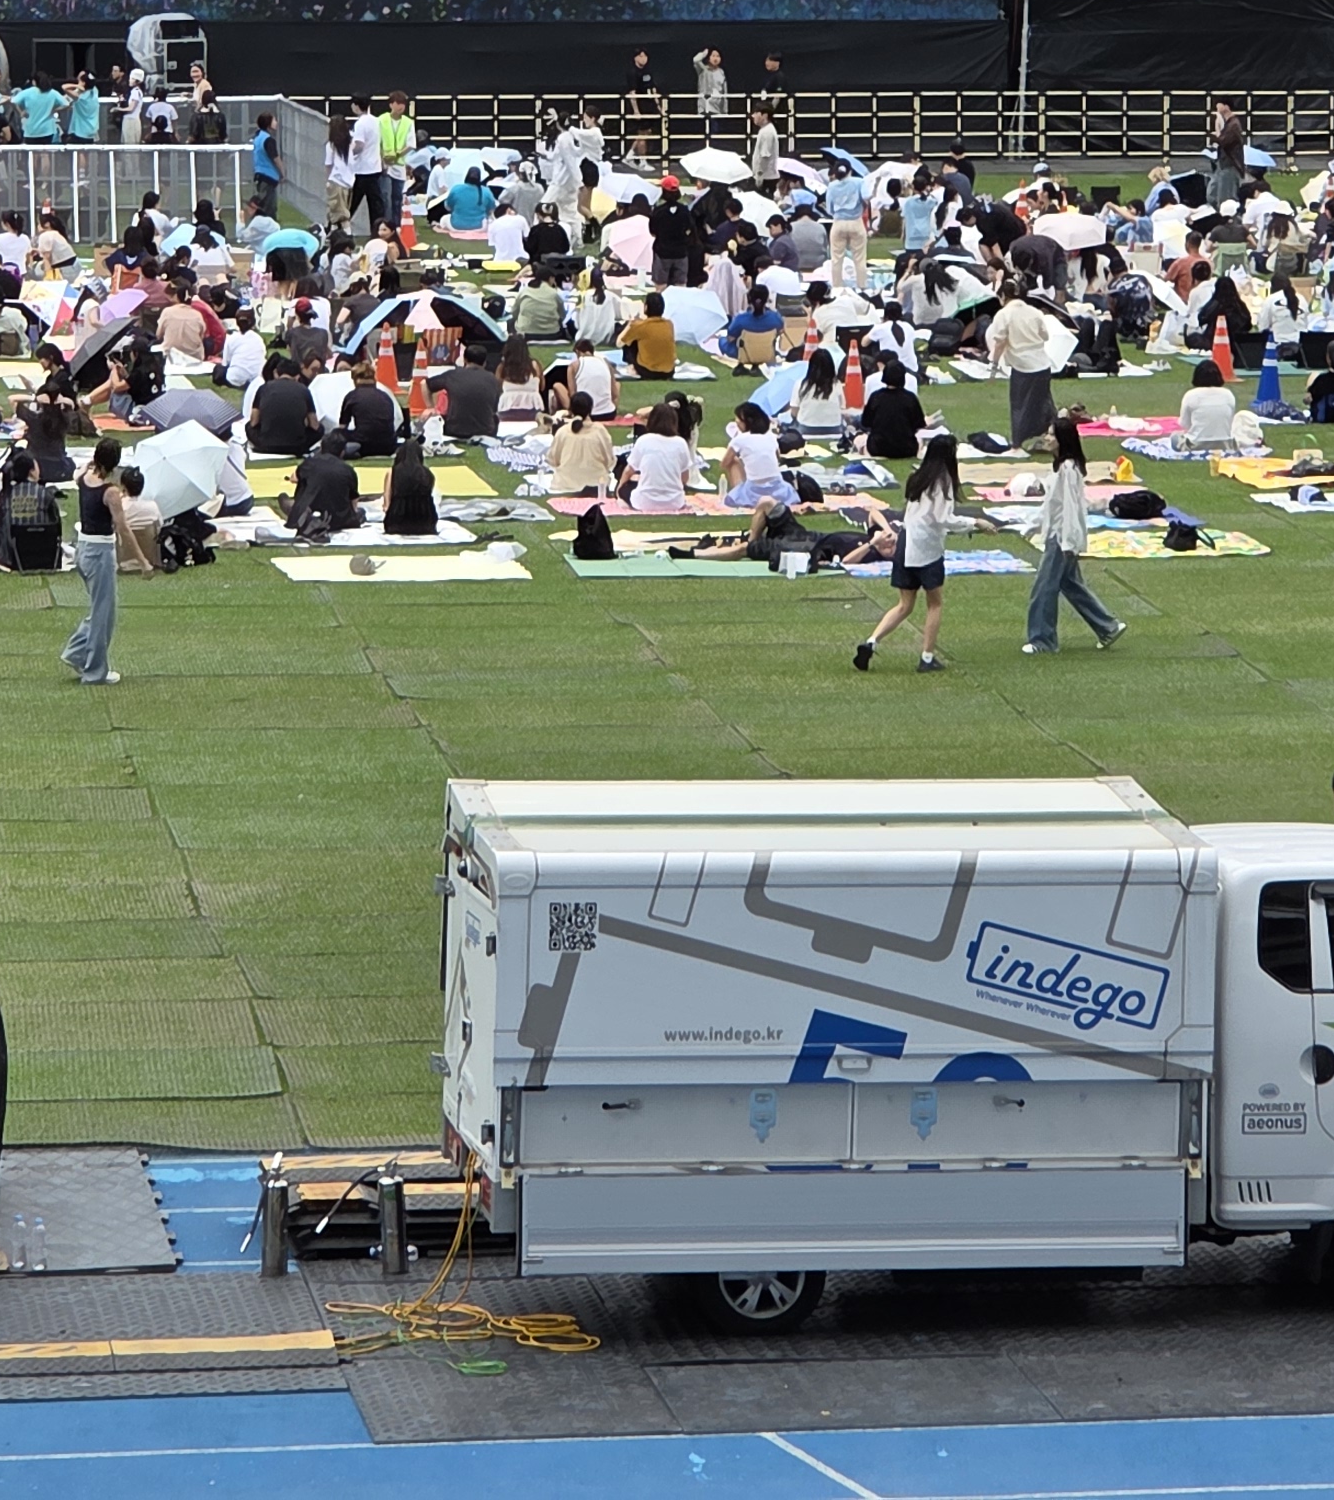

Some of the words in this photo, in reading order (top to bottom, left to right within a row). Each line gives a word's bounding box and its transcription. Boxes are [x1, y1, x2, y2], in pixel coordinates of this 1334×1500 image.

[984, 944, 1146, 1030] indego
[664, 1025, 784, 1045] www.indego.kr
[1242, 1102, 1291, 1112] POWERED
[1293, 1102, 1306, 1112] BY
[1247, 1117, 1302, 1130] aeonus
